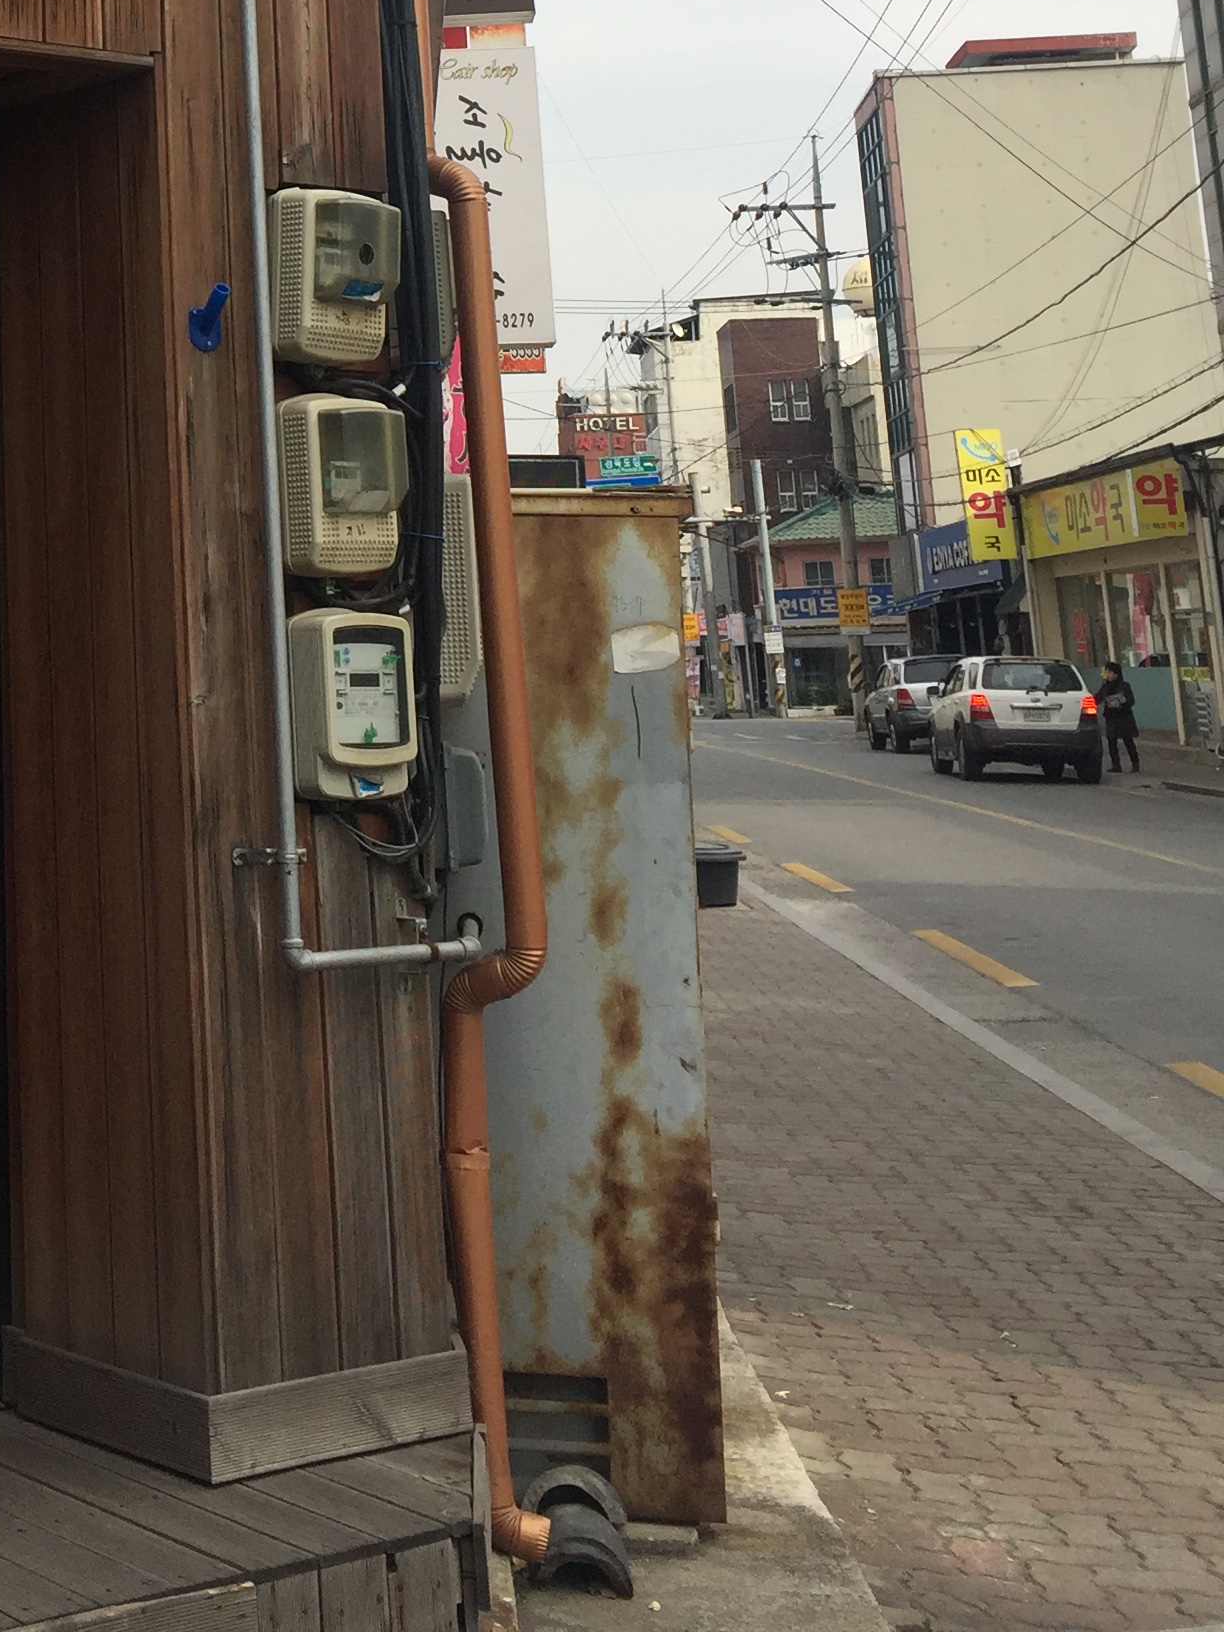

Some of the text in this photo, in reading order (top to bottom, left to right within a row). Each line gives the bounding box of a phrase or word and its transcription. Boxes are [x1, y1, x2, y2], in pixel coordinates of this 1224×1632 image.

[480, 59, 519, 86] shop
[496, 312, 535, 328] -8279
[575, 416, 639, 431] HOTEL
[966, 468, 1002, 485] 미소
[1136, 473, 1179, 515] 약
[1065, 479, 1125, 541] 미소약국
